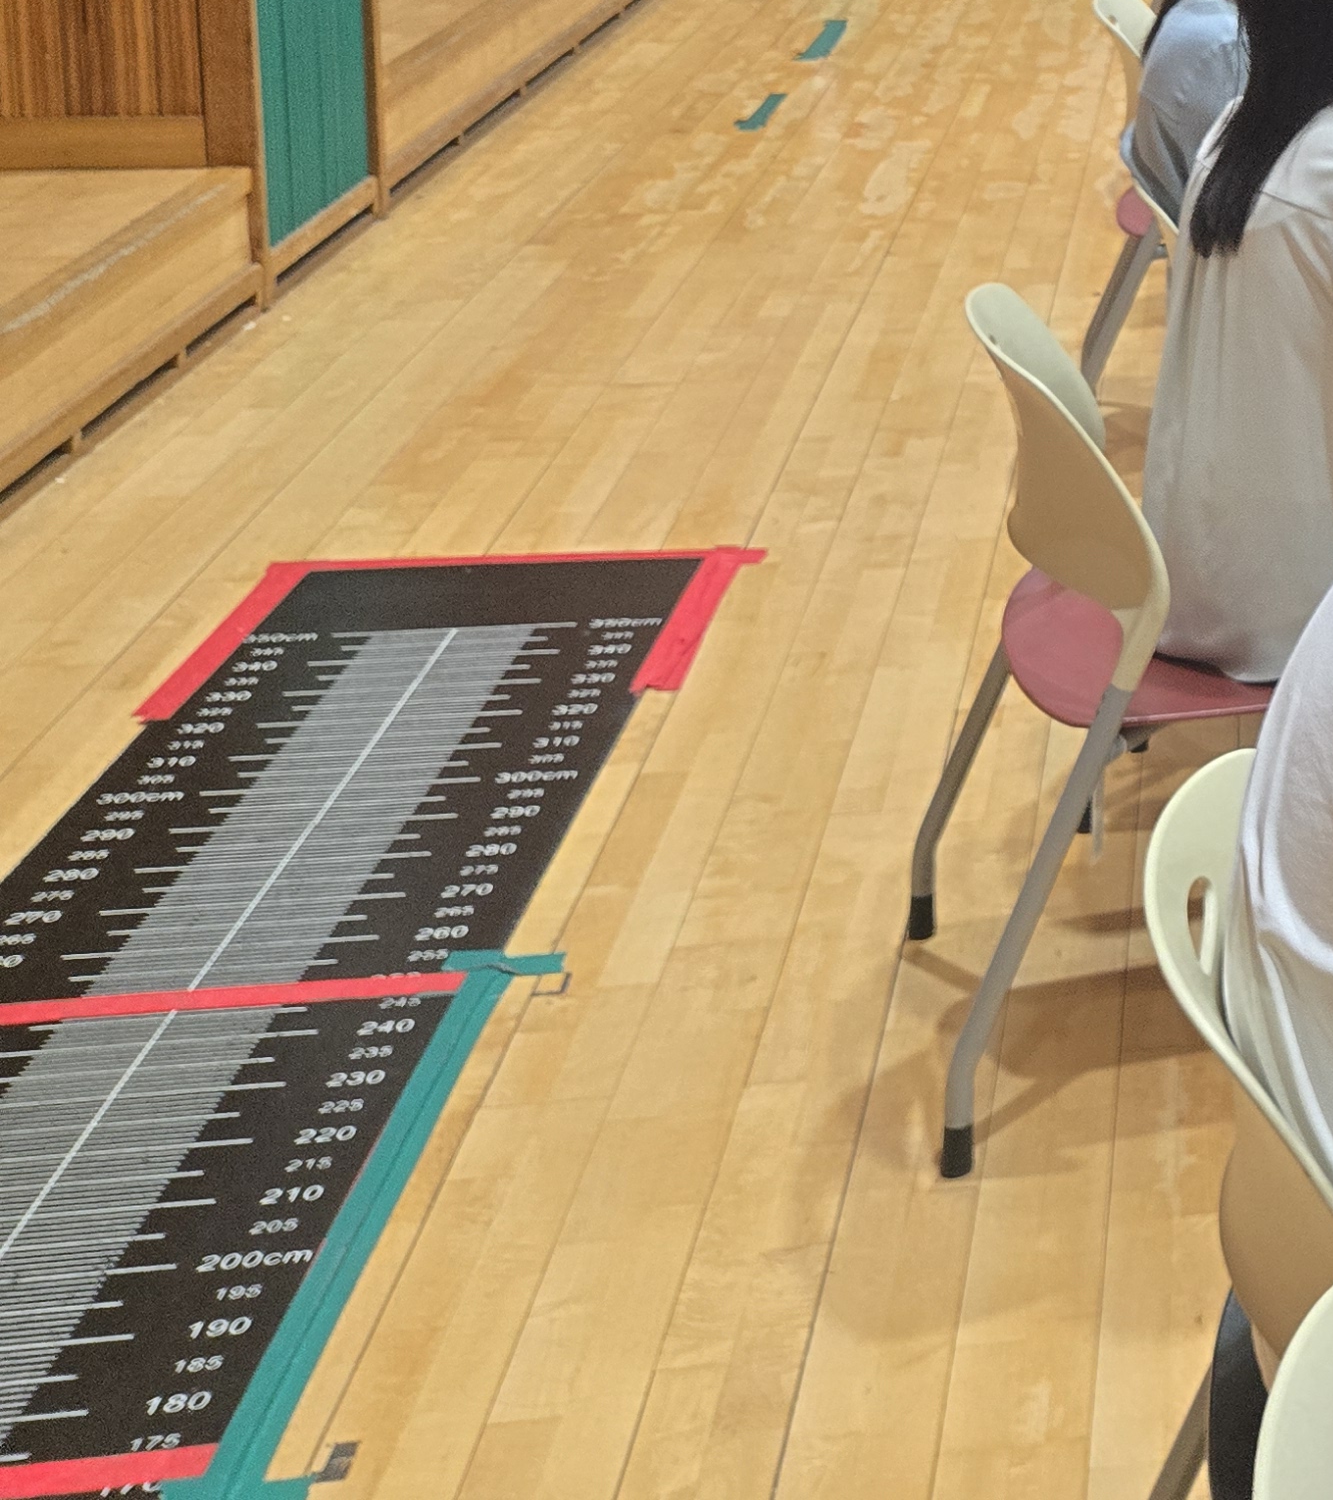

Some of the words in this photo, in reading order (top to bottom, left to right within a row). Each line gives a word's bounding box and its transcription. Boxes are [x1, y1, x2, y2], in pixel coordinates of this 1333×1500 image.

[494, 768, 579, 786] 300cm
[96, 789, 184, 806] 300cm
[489, 804, 542, 820] 290
[465, 842, 518, 859] 280
[440, 882, 494, 899] 270
[5, 908, 63, 927] 270
[414, 924, 470, 942] 260
[356, 1017, 417, 1037] 240
[348, 1044, 394, 1060] 235
[325, 1069, 386, 1088] 230
[317, 1097, 365, 1115] 225
[294, 1124, 358, 1146] 220
[284, 1155, 334, 1174] 215
[259, 1183, 326, 1206] 210
[248, 1217, 300, 1237] 205
[195, 1248, 313, 1274] 200cm
[215, 1283, 264, 1302] 195
[187, 1315, 254, 1341] 190
[173, 1354, 225, 1374] 185
[145, 1390, 214, 1417] 180
[129, 1432, 182, 1452] 175
